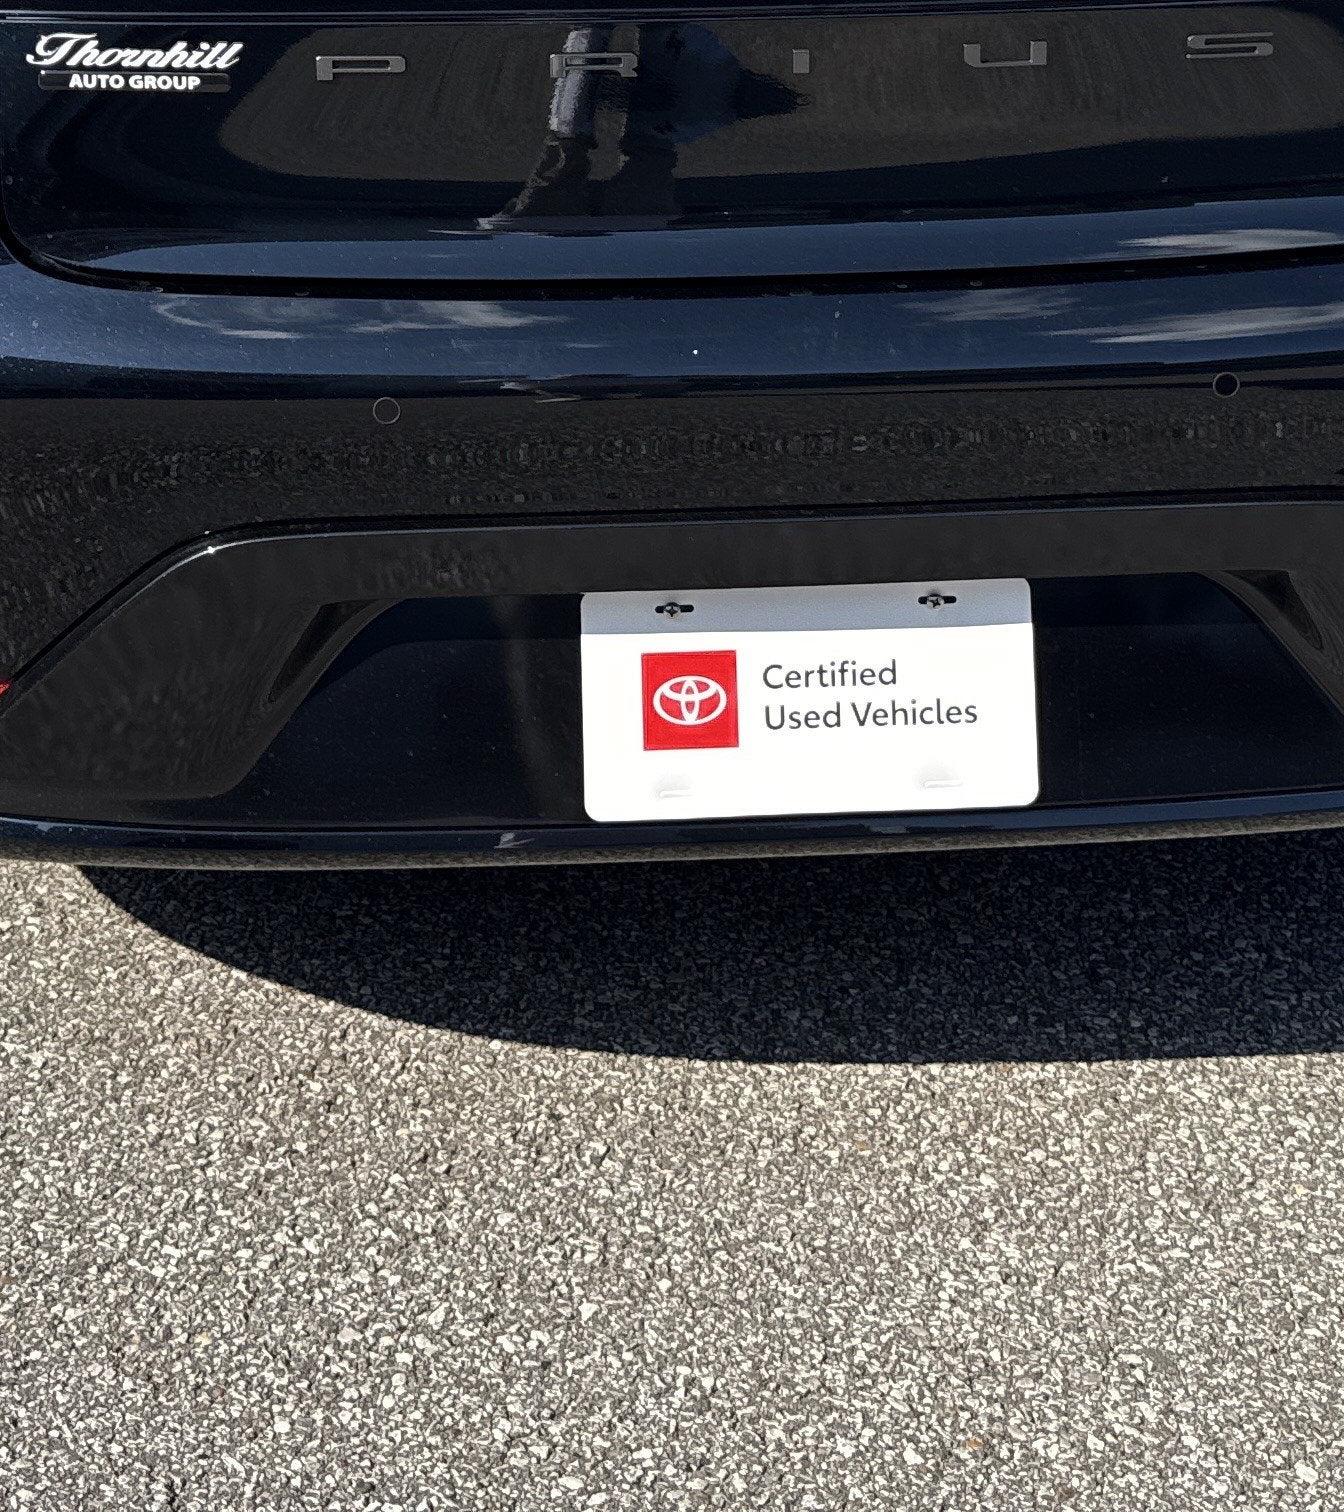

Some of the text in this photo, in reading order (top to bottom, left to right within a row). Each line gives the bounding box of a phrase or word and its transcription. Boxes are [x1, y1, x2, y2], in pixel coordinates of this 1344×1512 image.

[25, 32, 244, 69] Thornhill
[315, 31, 1275, 81] PRIUS
[68, 73, 202, 90] AUTO GROUP
[762, 658, 897, 689] Certified
[764, 697, 978, 730] Used Vehicles
